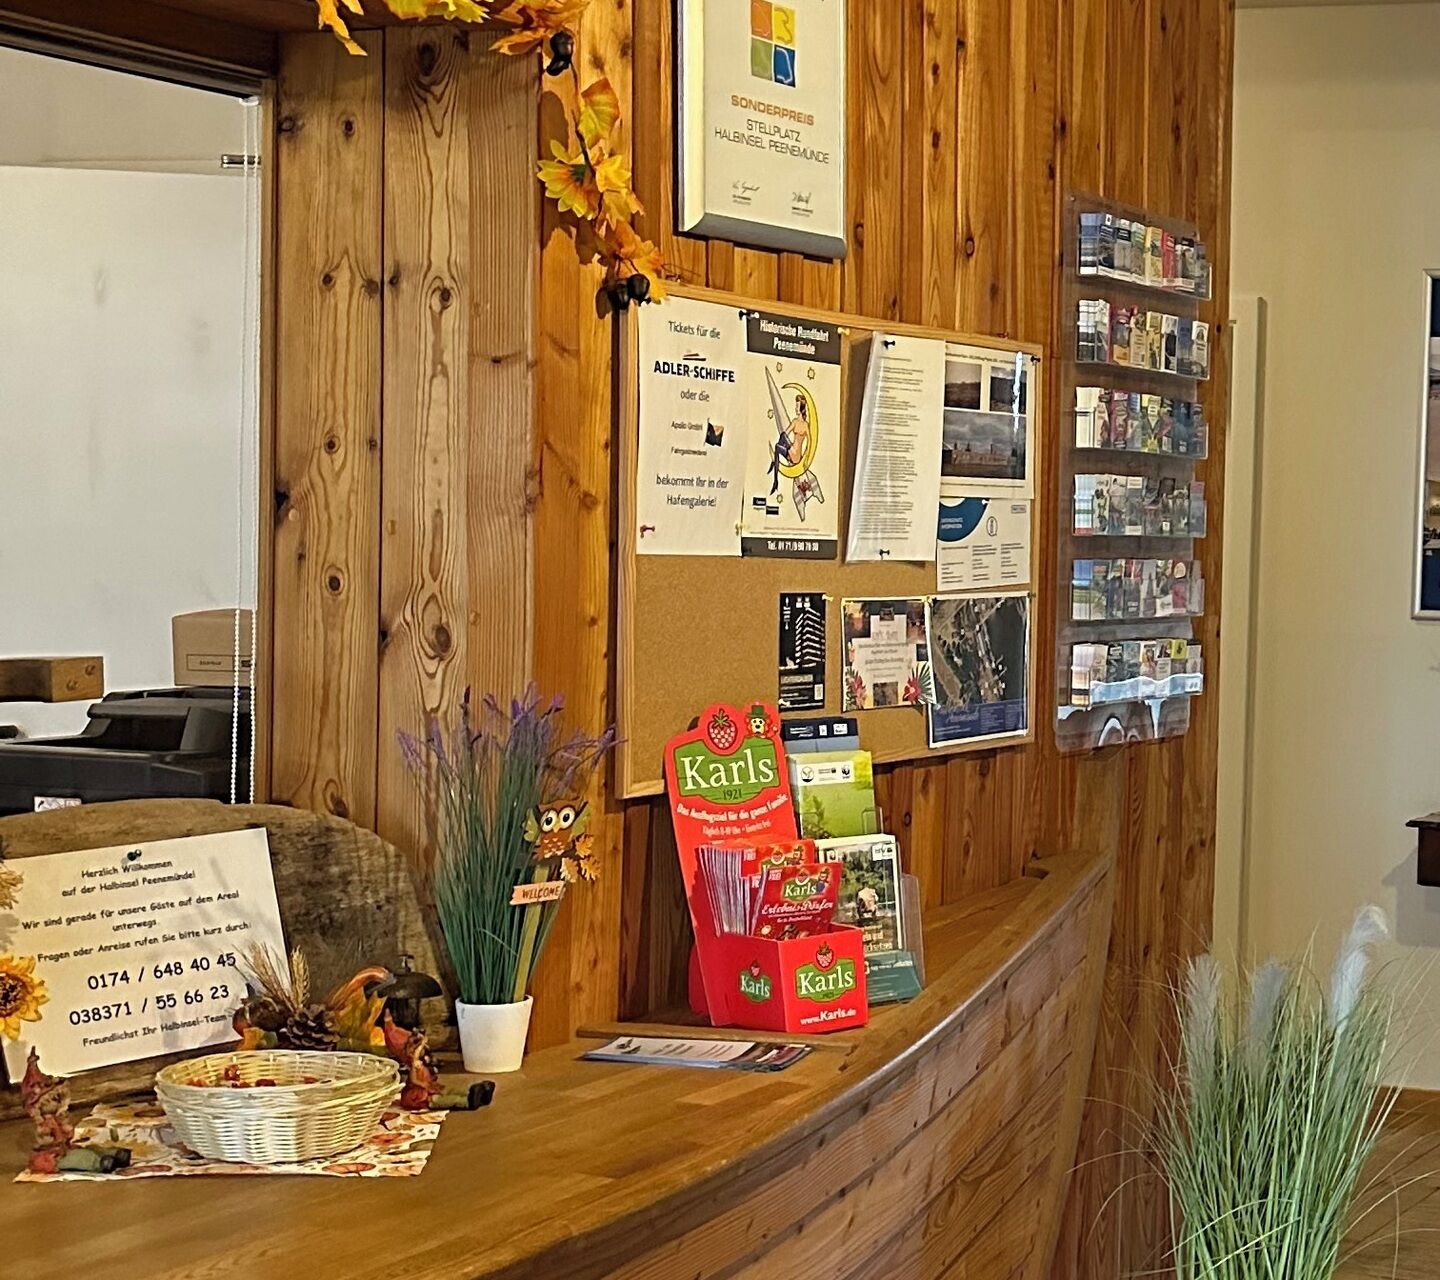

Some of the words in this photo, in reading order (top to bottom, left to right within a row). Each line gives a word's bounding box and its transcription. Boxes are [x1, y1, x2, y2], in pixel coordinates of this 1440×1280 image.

[731, 95, 814, 126] SONDERPREIS
[746, 119, 801, 142] STELLPLATZ
[715, 127, 766, 149] HALBINSEL
[769, 140, 829, 164] PEENEMÜNDE
[669, 320, 695, 335] Tickets
[696, 322, 708, 336] für
[709, 328, 721, 340] die
[654, 360, 735, 383] ADLER-SCHIFFE
[680, 389, 697, 401] oder
[699, 392, 710, 402] die
[656, 474, 694, 488] bekommt
[696, 478, 707, 488] Ihr
[708, 479, 715, 488] in
[716, 479, 729, 489] der
[667, 496, 716, 510] Hafengalerie!
[681, 749, 774, 790] Karls
[722, 789, 742, 801] 1921
[82, 866, 119, 878] Herzlich
[122, 860, 172, 873] Willkommen
[62, 887, 76, 897] auf
[81, 885, 96, 894] der
[100, 879, 139, 891] Halbinsel
[522, 886, 560, 899] WELCOME
[785, 881, 817, 897] Karls
[22, 921, 40, 930] Wir
[44, 916, 62, 927] sind
[66, 912, 97, 926] gerade
[100, 910, 115, 919] für
[117, 906, 147, 916] unsere
[150, 901, 175, 911] Gäste
[178, 897, 192, 907] auf
[196, 896, 213, 904] dem
[217, 890, 239, 900] Areal
[38, 950, 70, 963] Fragen
[73, 947, 94, 957] oder
[98, 941, 131, 953] Anreise
[134, 936, 159, 947] rufen
[162, 934, 176, 943] Sie
[179, 931, 200, 940] bitte
[203, 927, 222, 936] kurz
[88, 970, 130, 990] 0174
[138, 967, 145, 982] /
[154, 962, 183, 979] 648
[191, 957, 210, 971] 40
[217, 952, 236, 967] 45
[799, 966, 853, 995] Karls
[740, 974, 770, 997] Karls
[69, 1001, 132, 1026] 038371
[141, 998, 148, 1014] /
[156, 993, 177, 1010] 55
[184, 991, 204, 1005] 66
[210, 985, 229, 1000] 23
[800, 1008, 856, 1024] www.Karls.de
[83, 1029, 139, 1047] Freundlichst
[142, 1026, 157, 1036] Ihr
[160, 1014, 228, 1032] Halbinsel-Team
